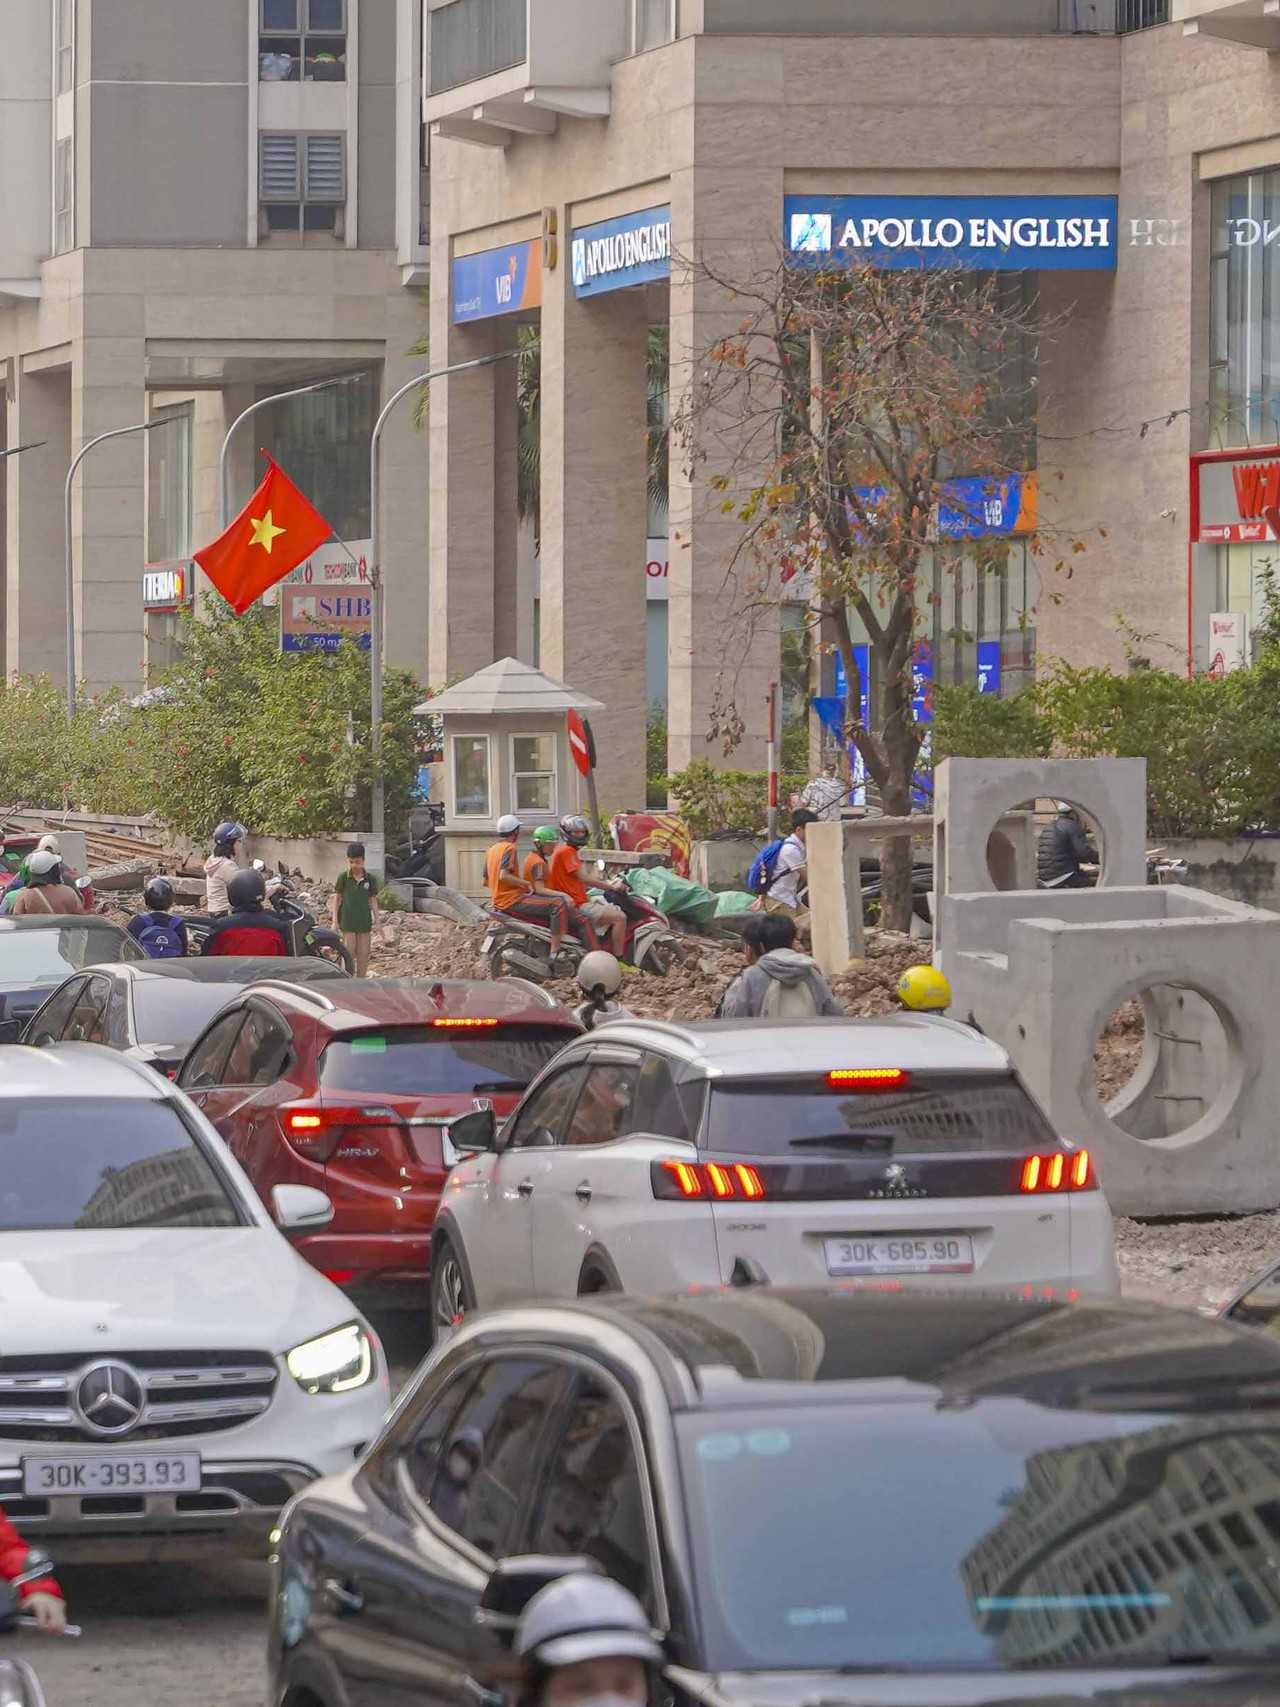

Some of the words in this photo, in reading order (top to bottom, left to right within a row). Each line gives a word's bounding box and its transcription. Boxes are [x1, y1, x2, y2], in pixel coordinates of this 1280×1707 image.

[839, 218, 964, 248] APOLLO
[968, 218, 1111, 248] ENGLISH
[586, 233, 625, 276] APOLLO
[624, 222, 671, 267] ENGLISH
[495, 274, 512, 304] VIB
[320, 597, 372, 617] SHB
[41, 1461, 187, 1489] 30K-393.93
